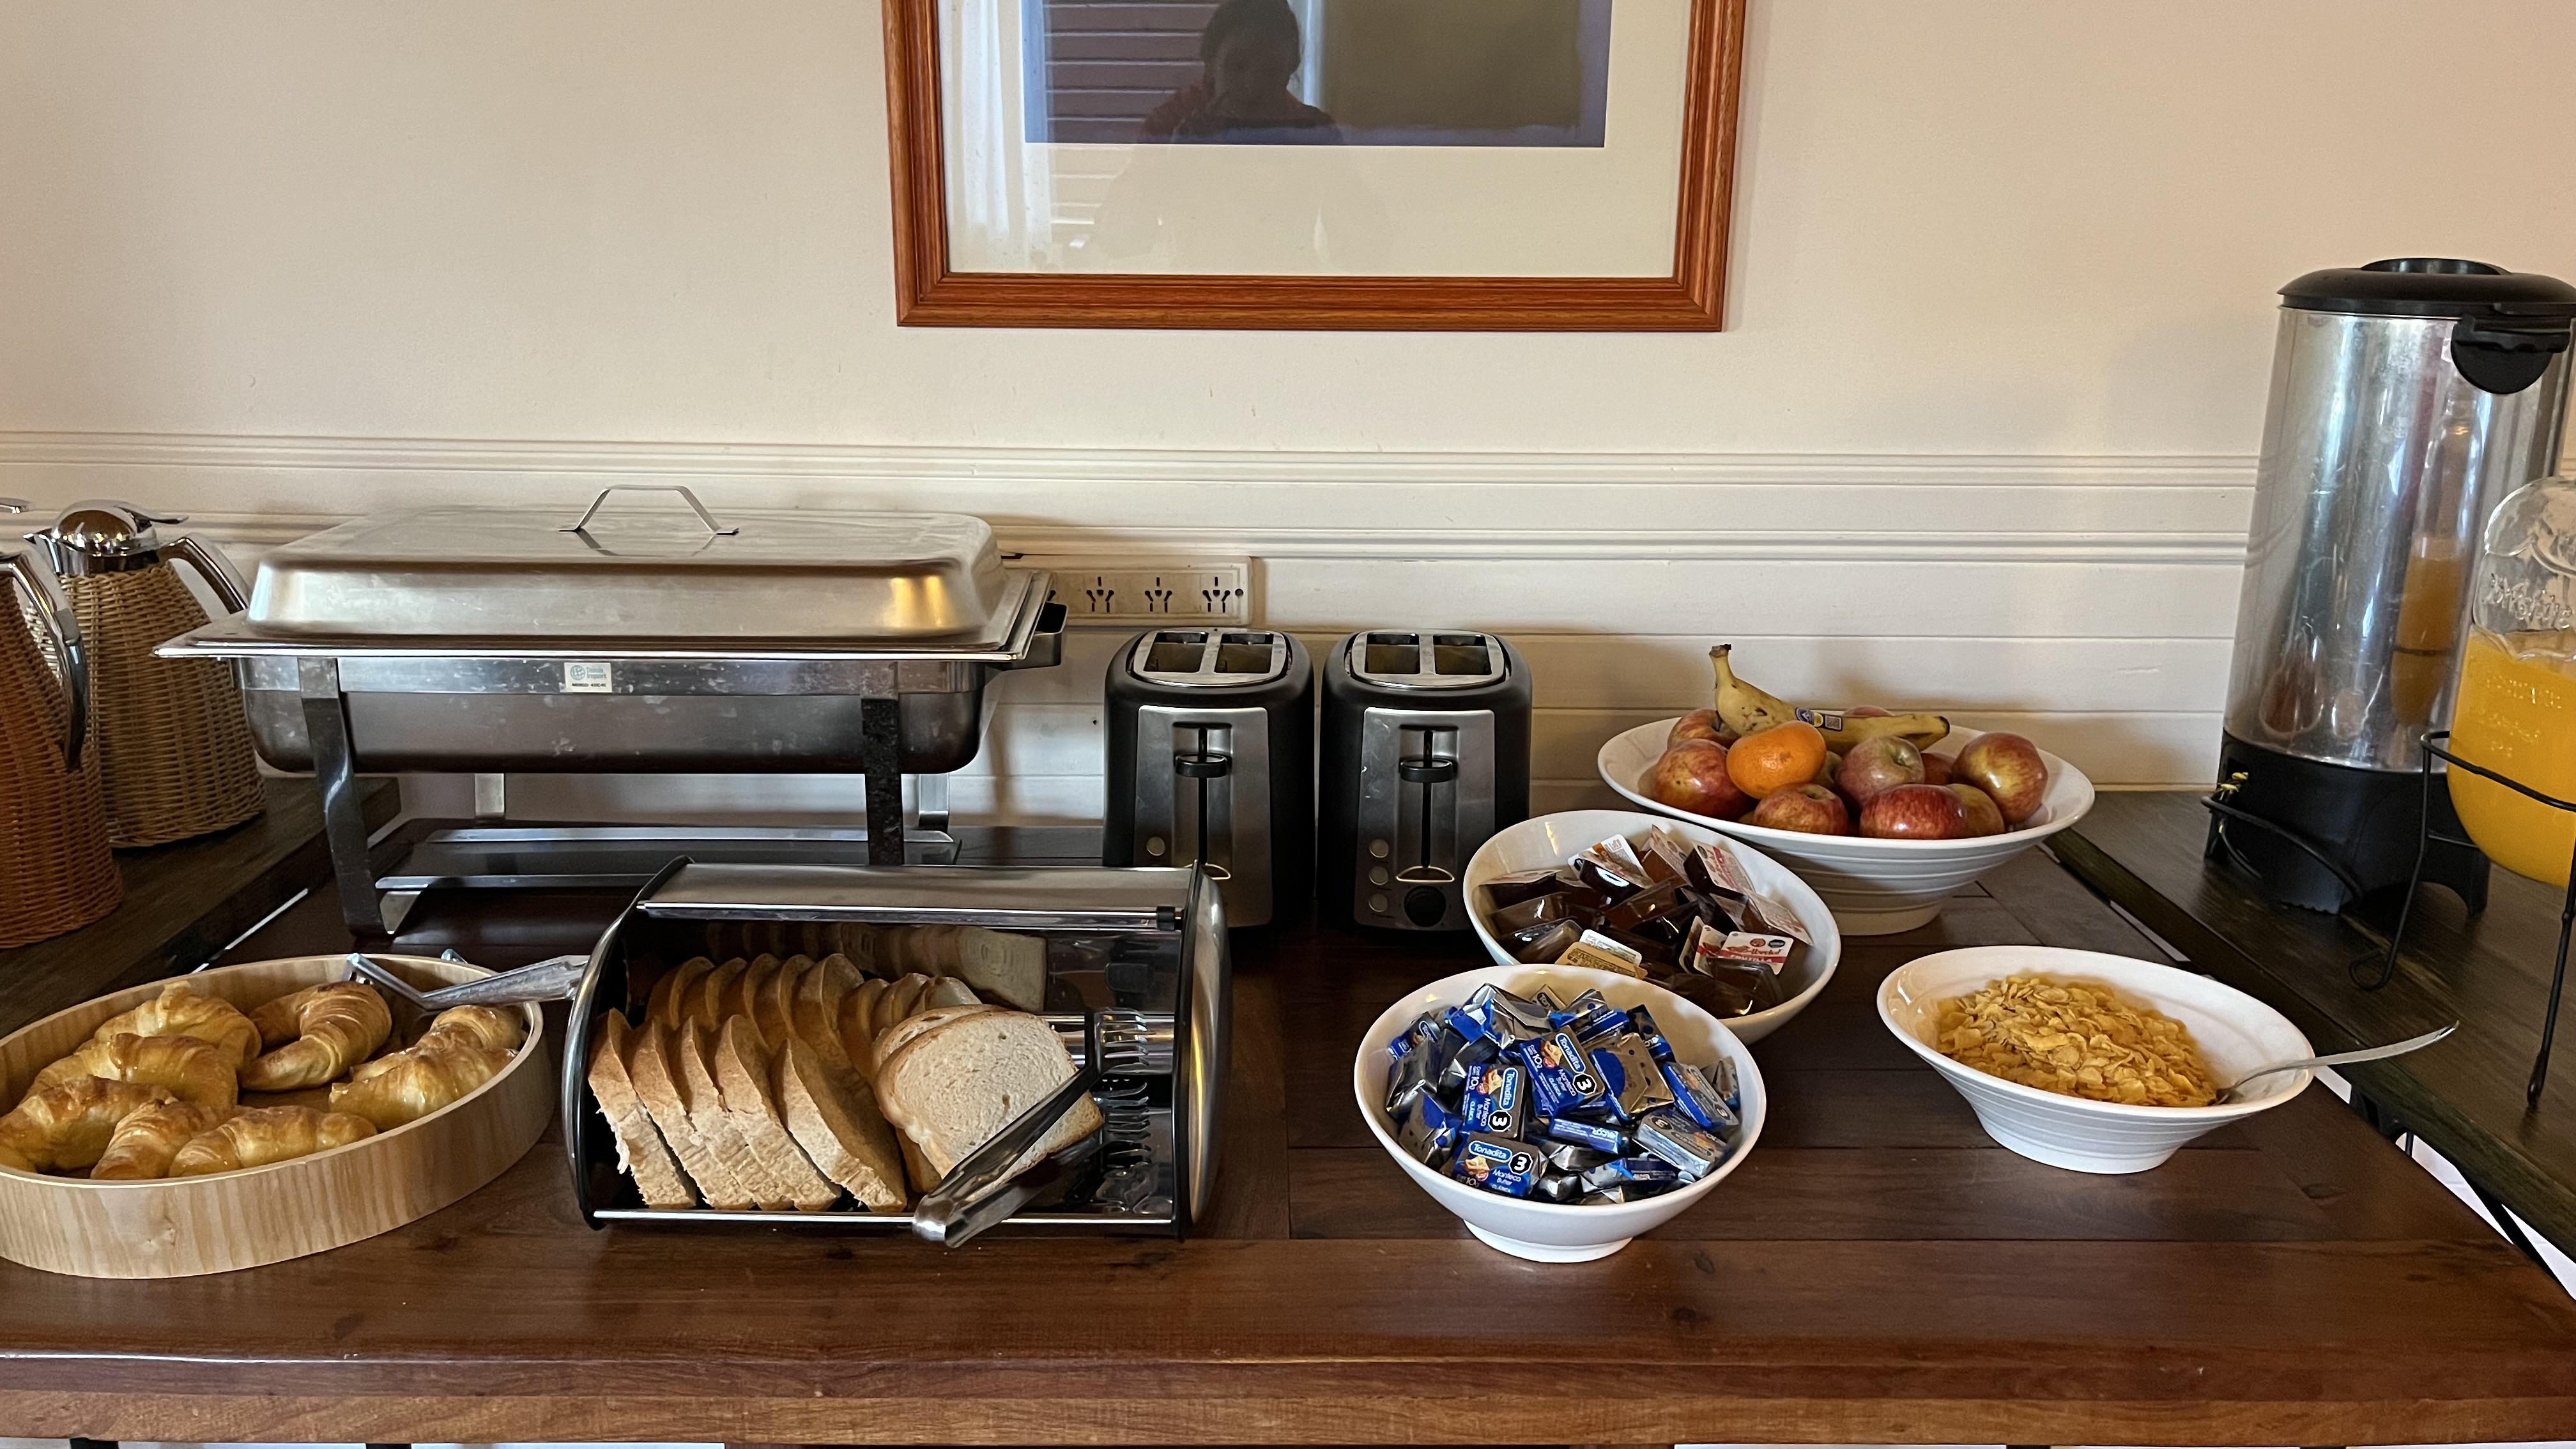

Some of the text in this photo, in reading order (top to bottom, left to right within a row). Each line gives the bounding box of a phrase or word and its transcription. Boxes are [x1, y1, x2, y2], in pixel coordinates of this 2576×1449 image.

[1559, 1036, 1581, 1070] Tonadita
[1503, 1071, 1515, 1107] Tonadita
[1576, 1078, 1592, 1091] 3
[1492, 1116, 1508, 1126] 3
[1473, 1143, 1507, 1160] Tonadita
[1514, 1156, 1528, 1171] 3
